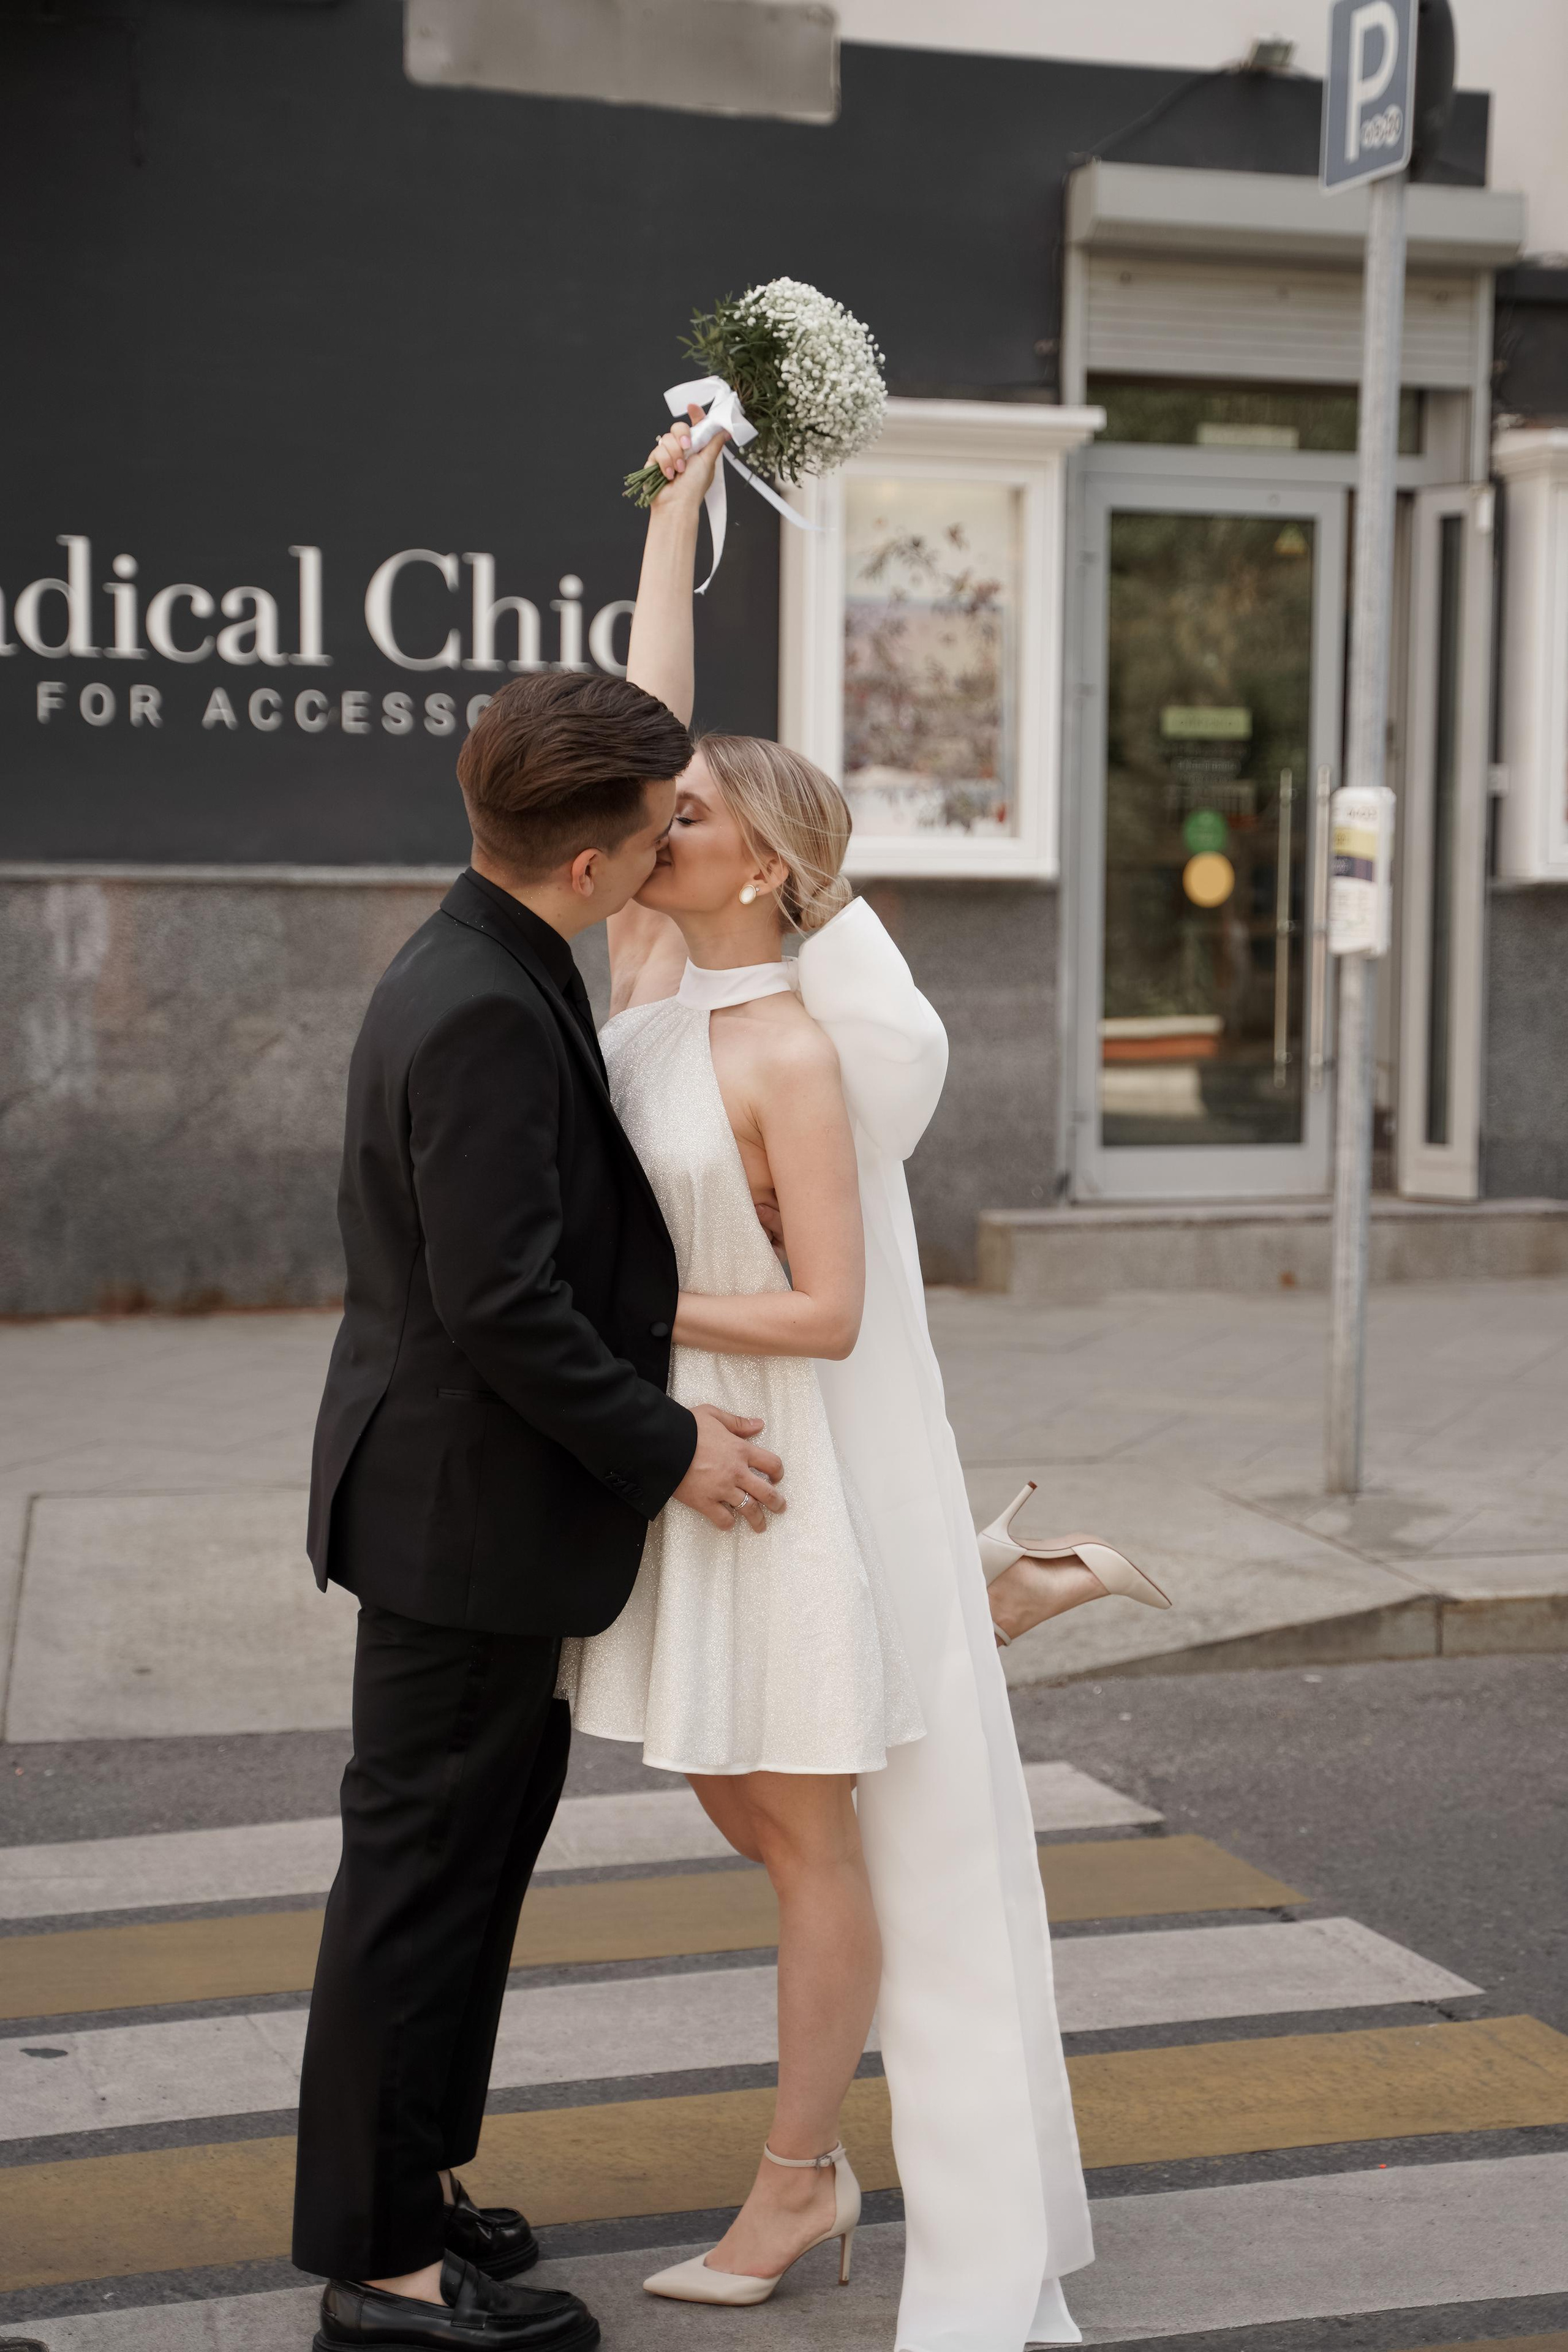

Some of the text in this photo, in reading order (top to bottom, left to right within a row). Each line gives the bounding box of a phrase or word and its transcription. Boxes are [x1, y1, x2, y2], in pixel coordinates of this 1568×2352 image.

[1345, 2, 1400, 163] P
[0, 535, 636, 677] dical Chic
[37, 681, 164, 728] FOR
